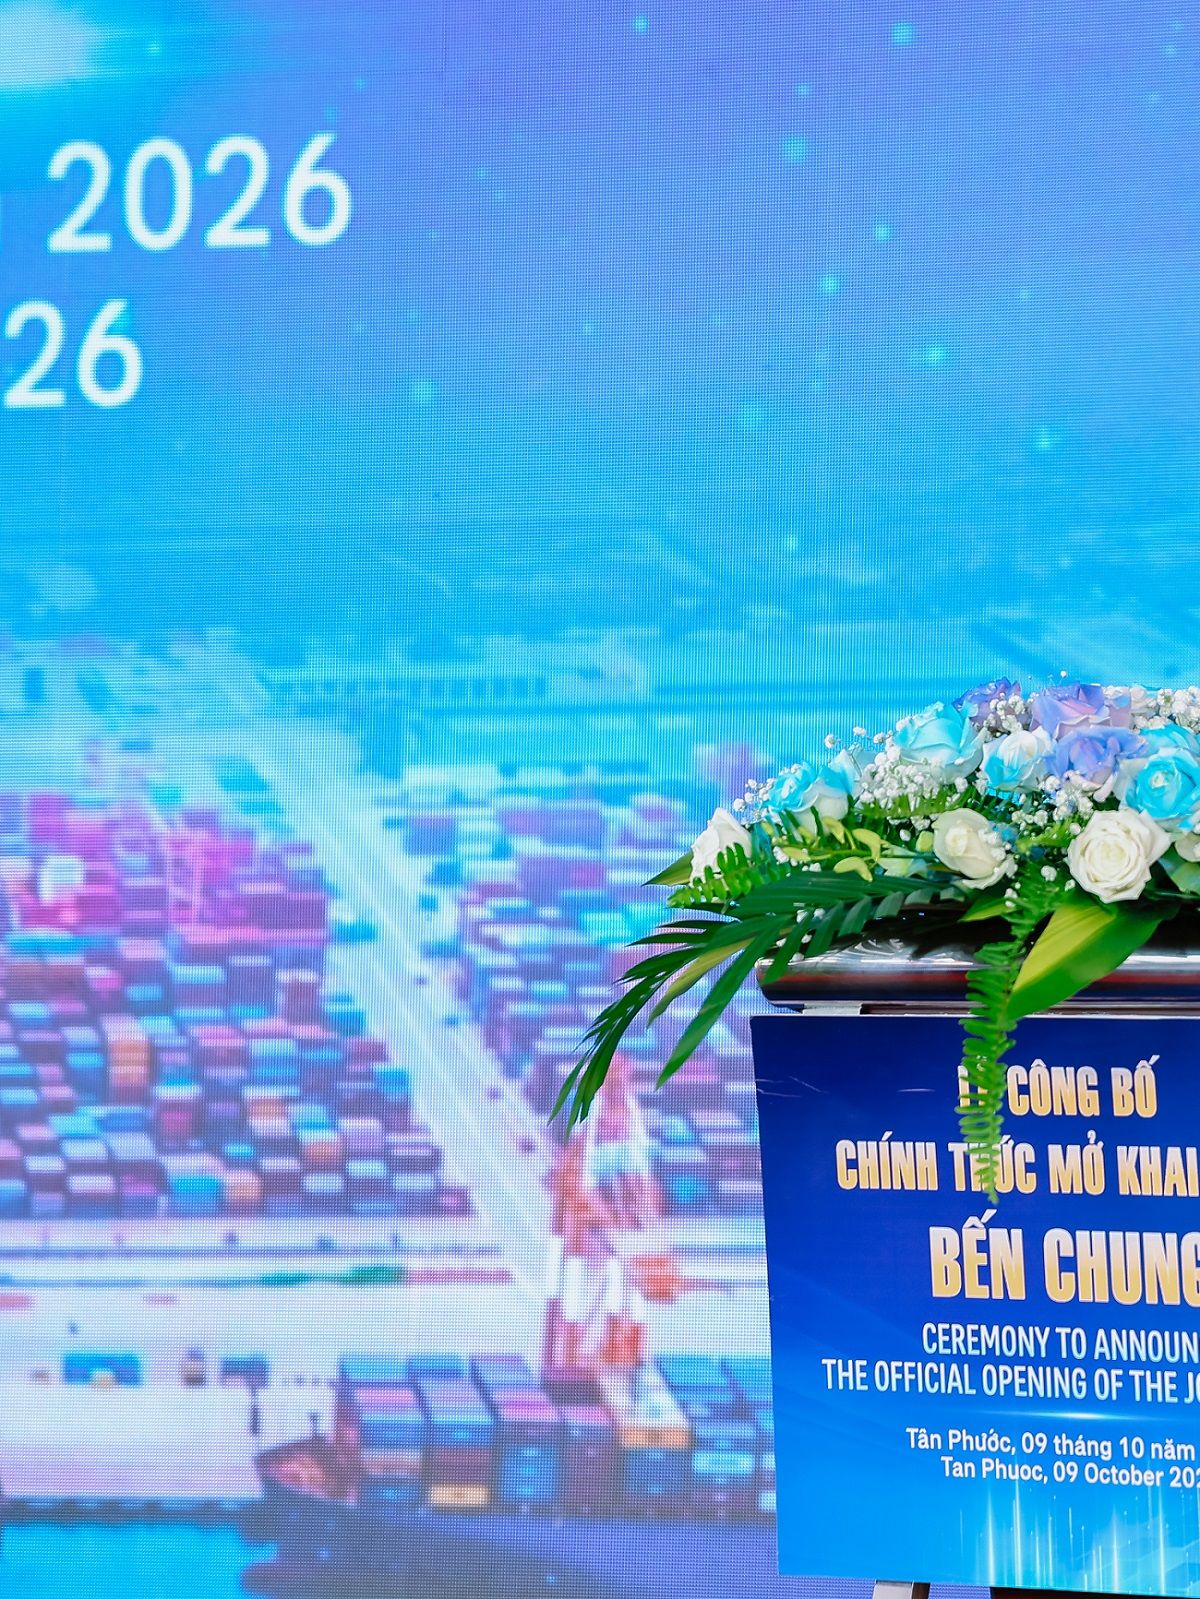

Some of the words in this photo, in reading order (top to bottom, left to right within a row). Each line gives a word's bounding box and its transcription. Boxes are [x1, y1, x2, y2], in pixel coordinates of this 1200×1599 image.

[47, 131, 353, 254] 2026
[1007, 1059, 1100, 1117] CÔNG
[1111, 1055, 1159, 1117] BỐ
[836, 1131, 938, 1190] CHÍNH
[1048, 1130, 1105, 1195] MỞ
[1117, 1146, 1199, 1197] KHAI
[930, 1209, 1025, 1300] BẾN
[923, 1323, 1050, 1357] CEREMONY
[1055, 1327, 1086, 1359] TO
[822, 1359, 868, 1390] THE
[875, 1361, 976, 1394] OFFICIAL
[983, 1365, 1086, 1398] OPENING
[1095, 1369, 1123, 1400] OF
[1129, 1370, 1177, 1402] THE
[906, 1428, 941, 1449] Tân
[949, 1429, 1015, 1455] Phước,
[1022, 1432, 1047, 1453] 09
[1053, 1434, 1112, 1460] tháng
[1120, 1437, 1144, 1458] 10
[1151, 1439, 1195, 1460] năm
[941, 1456, 975, 1477] Tan
[982, 1458, 1048, 1484] Phuoc,
[1054, 1461, 1078, 1482] 09
[1085, 1463, 1164, 1486] October
